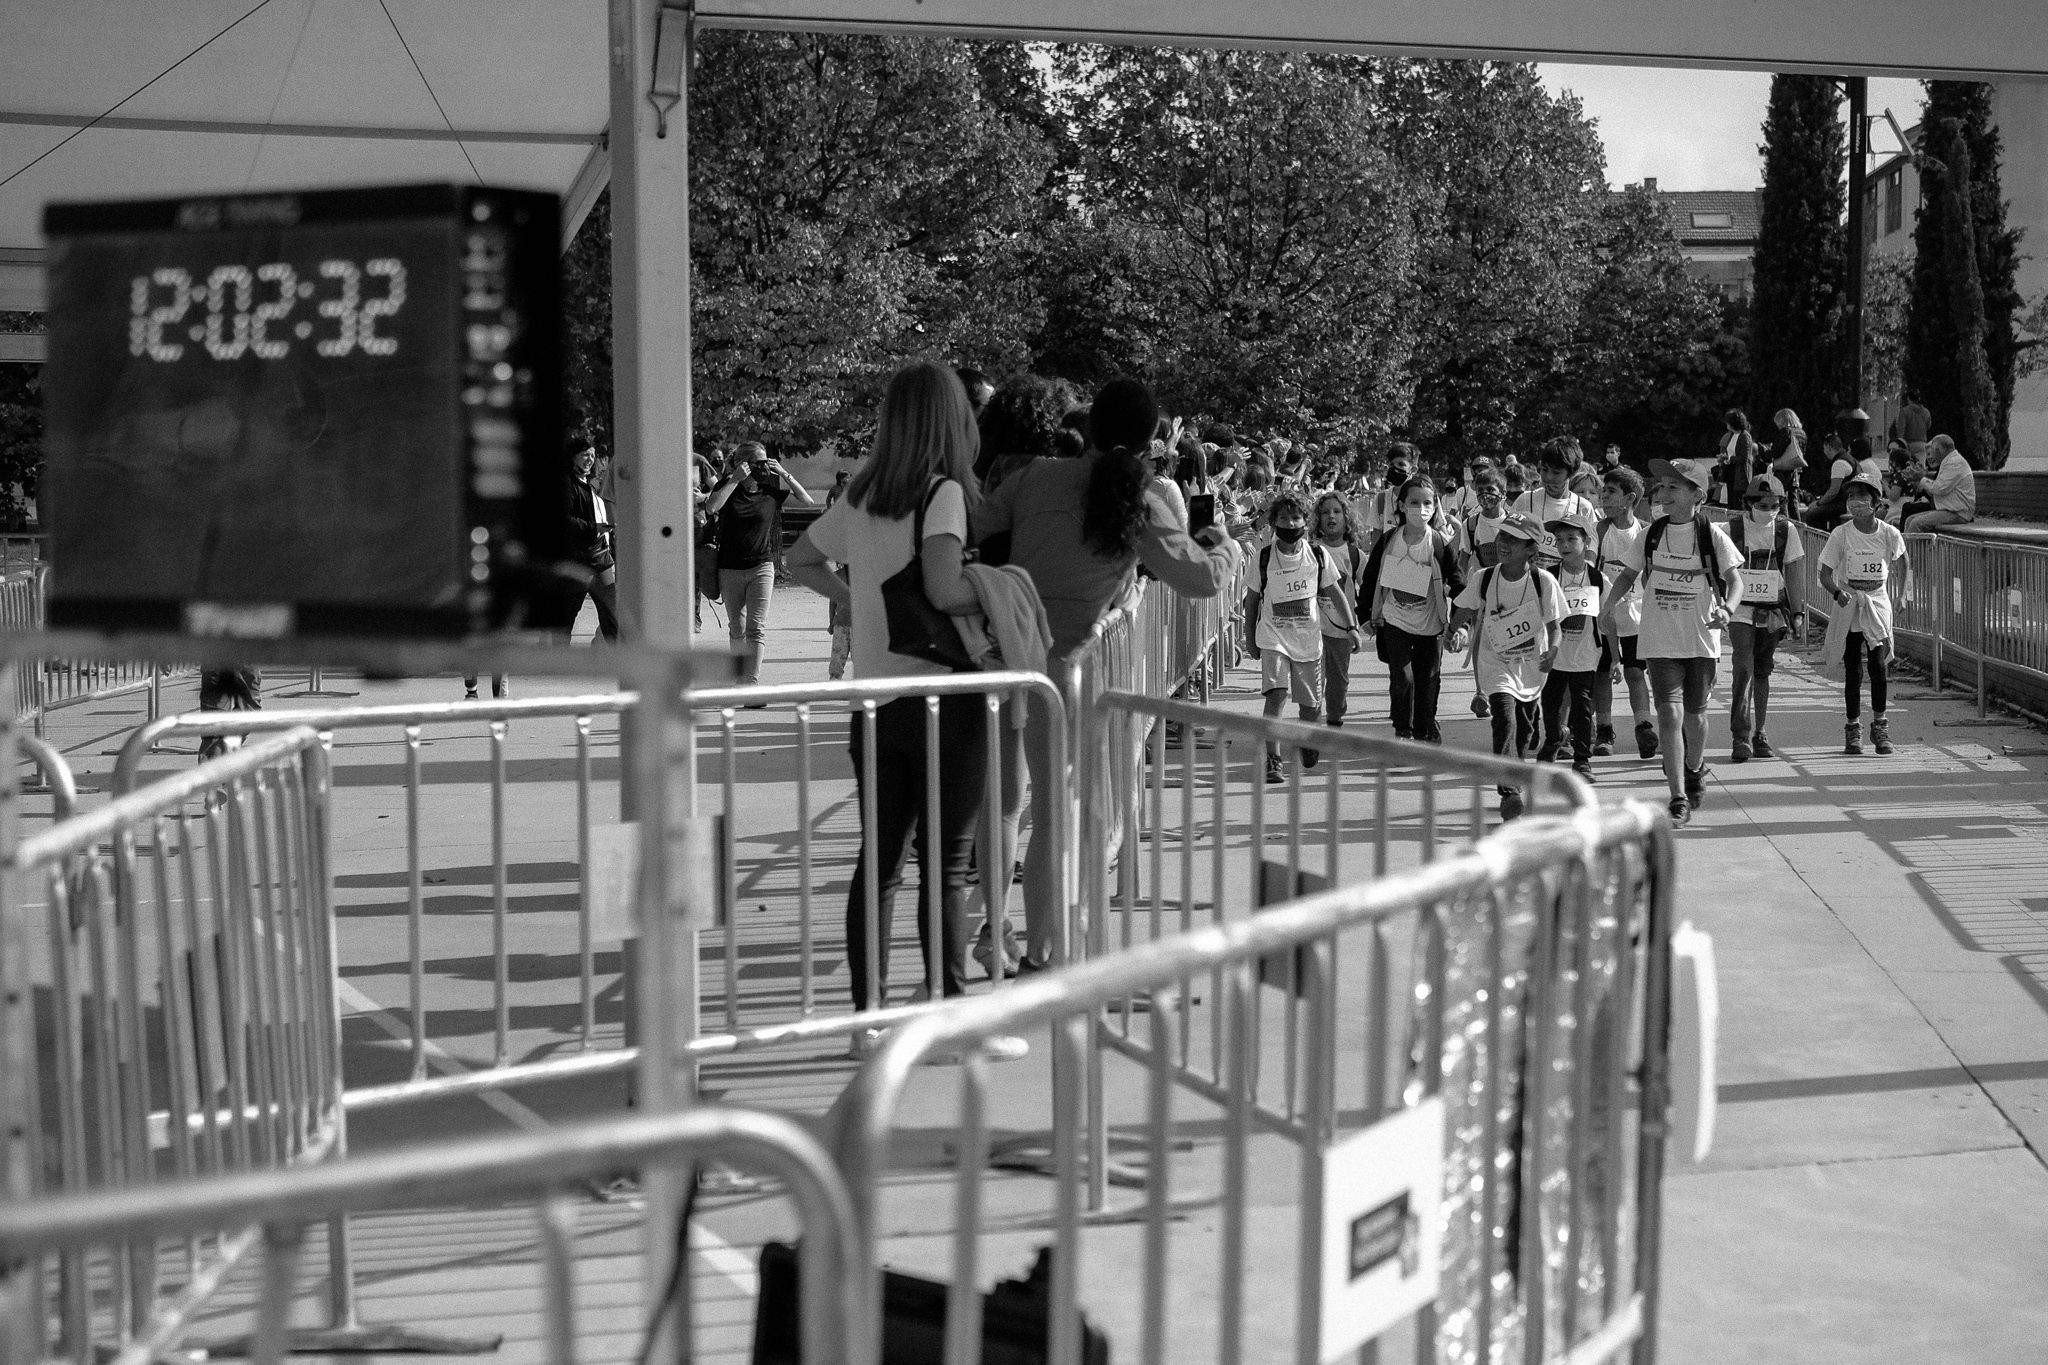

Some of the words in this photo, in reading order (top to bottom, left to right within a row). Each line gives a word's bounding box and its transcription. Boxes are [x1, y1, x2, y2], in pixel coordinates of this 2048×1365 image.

[129, 258, 407, 362] 12:02:32
[1862, 563, 1882, 573] 182
[1286, 580, 1308, 592] 164
[1749, 583, 1768, 593] 182
[1566, 598, 1588, 608] 176
[1506, 621, 1530, 639] 120
